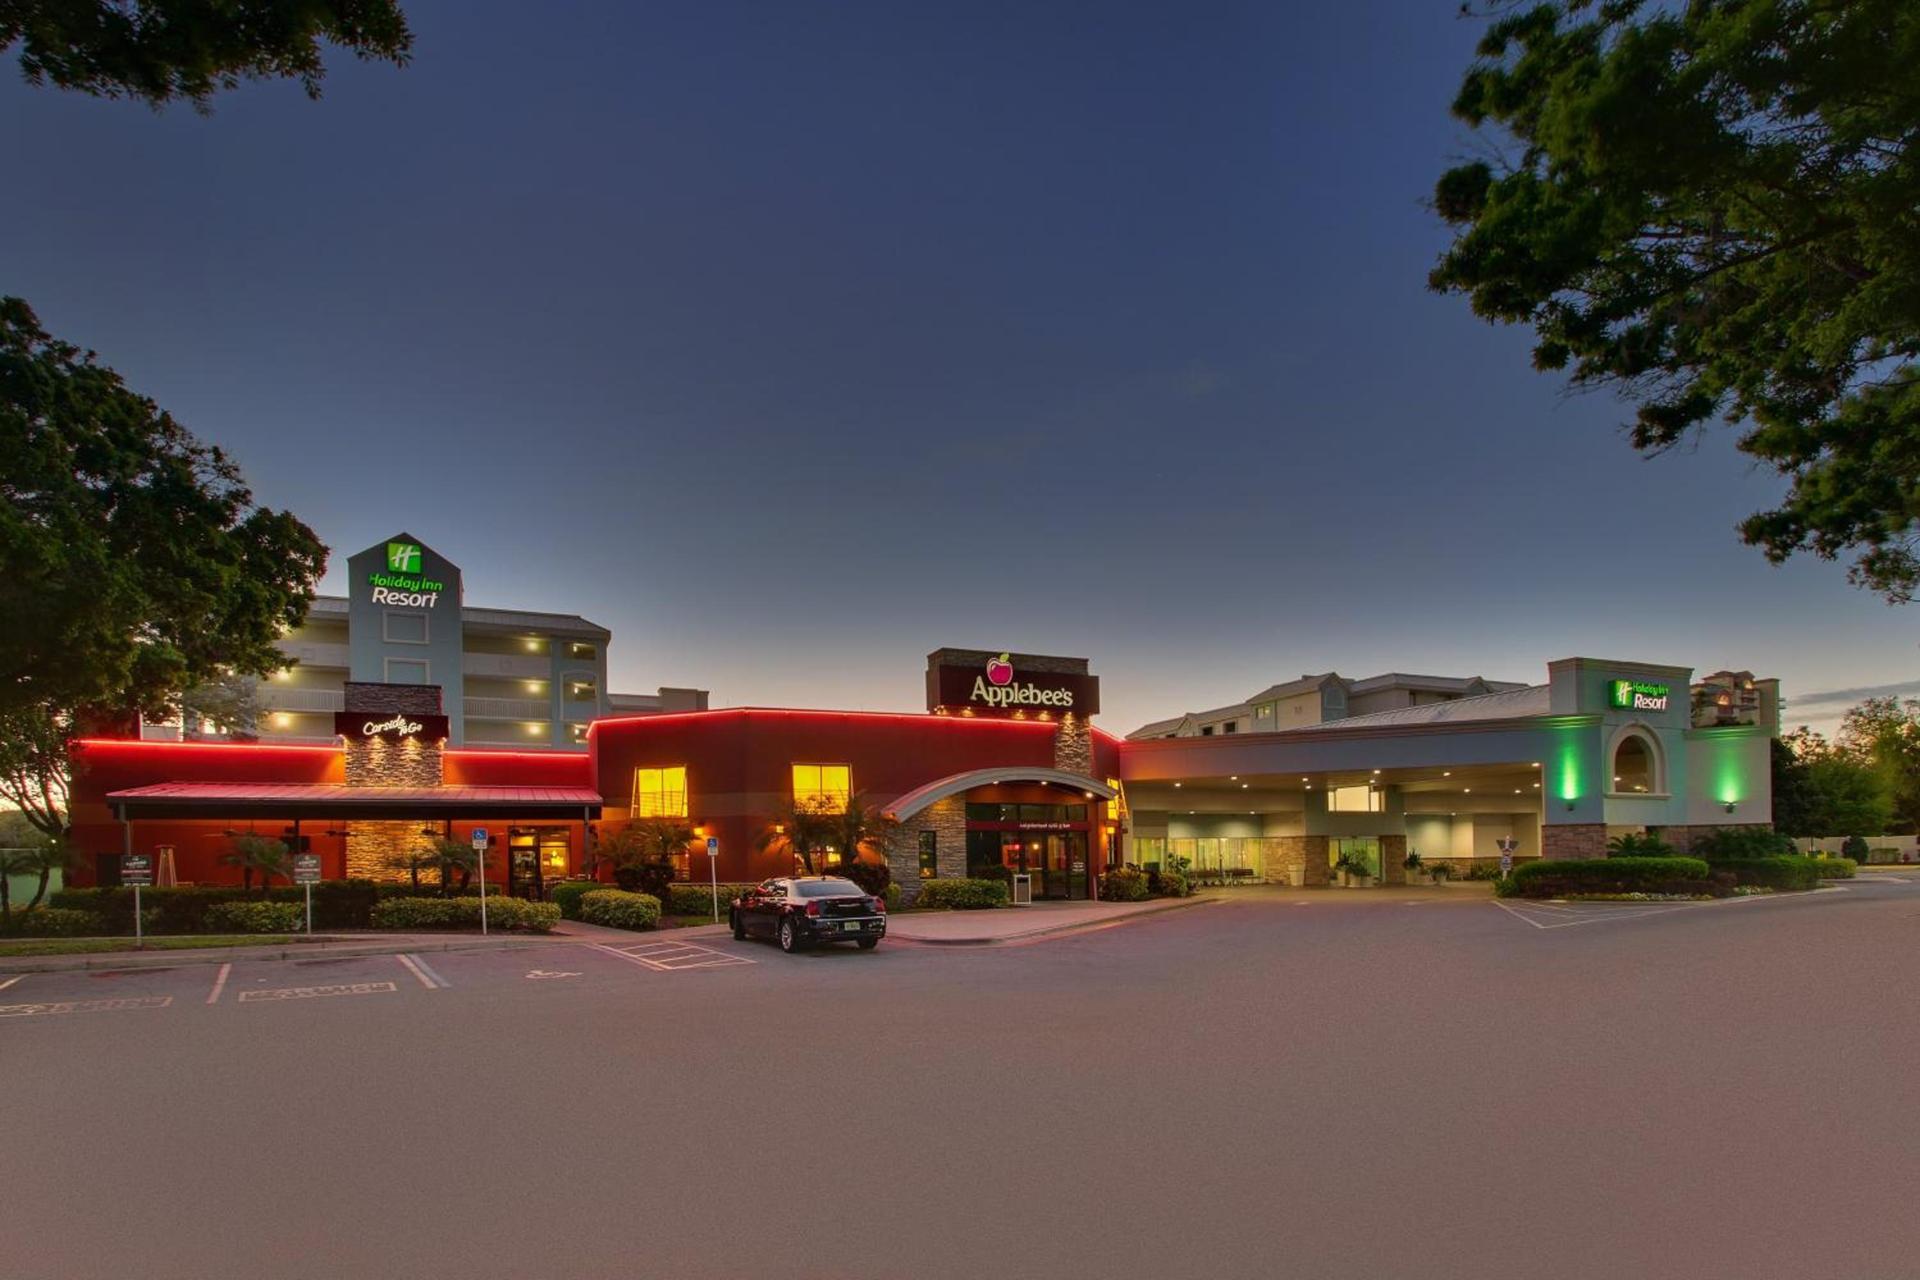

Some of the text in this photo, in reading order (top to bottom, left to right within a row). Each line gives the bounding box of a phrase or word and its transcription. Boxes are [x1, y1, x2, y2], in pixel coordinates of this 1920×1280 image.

[369, 573, 443, 591] Holiday Inn
[371, 586, 438, 608] Resort
[970, 675, 1074, 707] Applebee's
[1632, 682, 1658, 696] Holiday
[1634, 693, 1667, 710] Resort
[363, 714, 406, 735] Carside
[408, 722, 423, 734] Go
